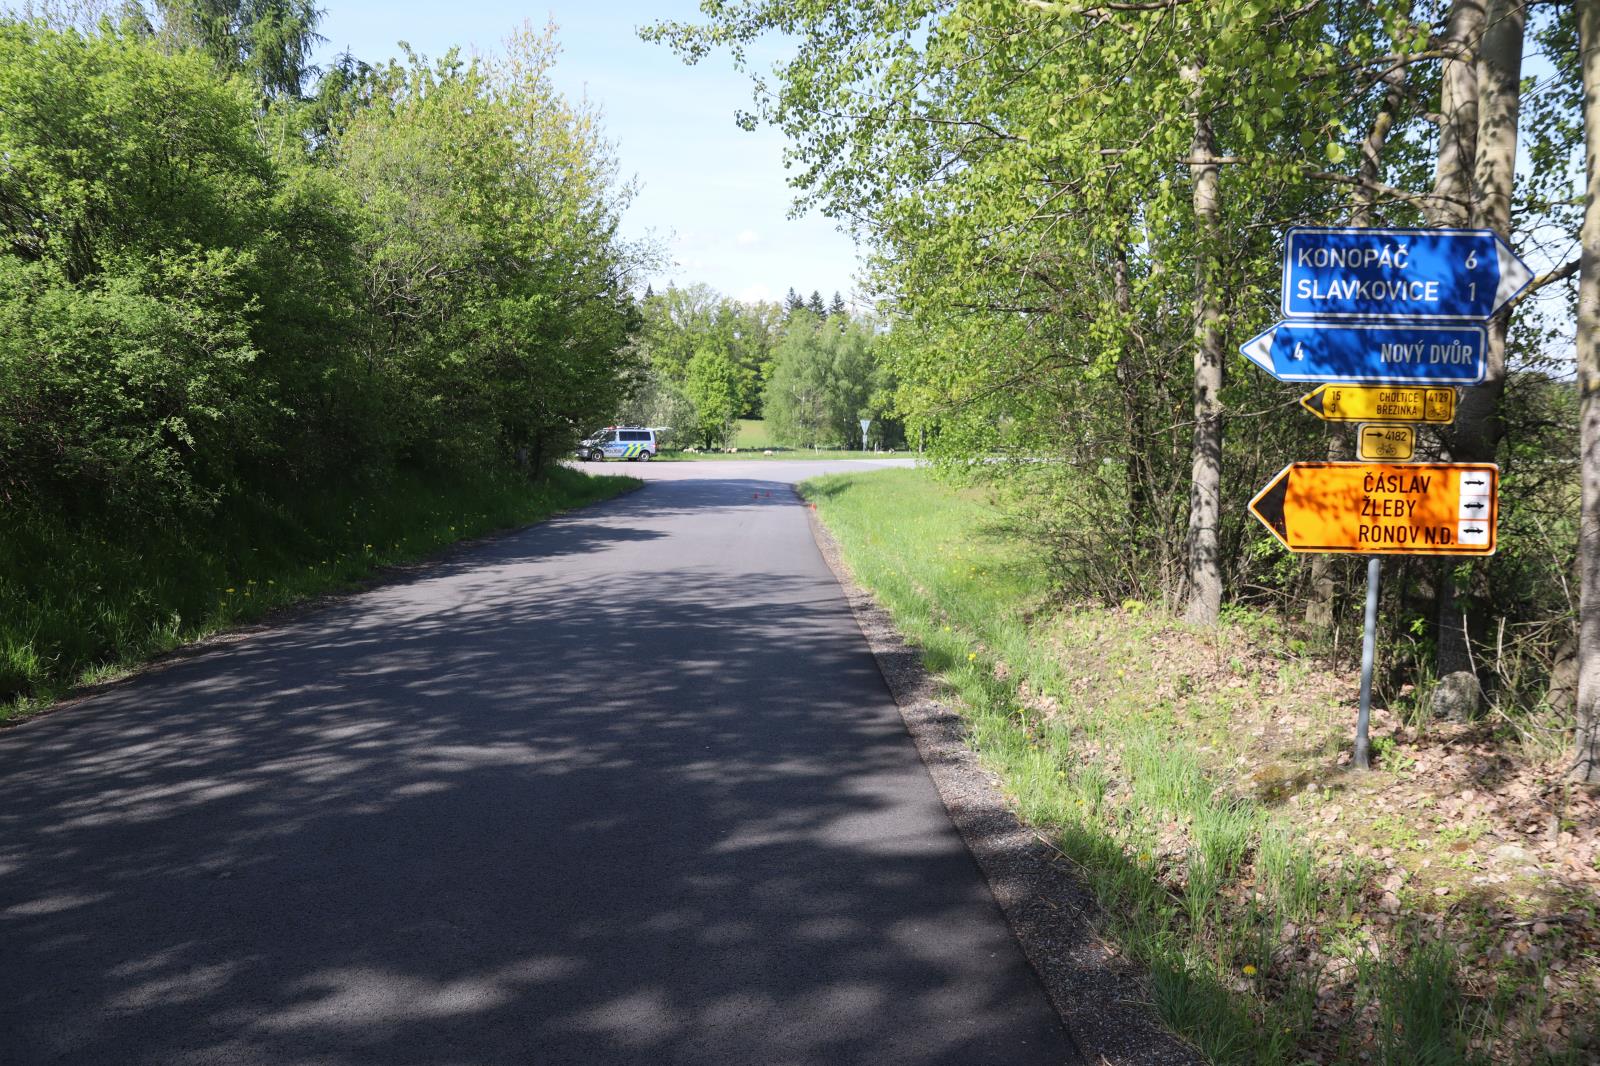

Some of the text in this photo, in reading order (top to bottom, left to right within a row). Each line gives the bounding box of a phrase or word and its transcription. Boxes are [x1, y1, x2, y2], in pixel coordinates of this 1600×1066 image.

[1297, 244, 1478, 270] KONOPÁČ 6
[1296, 279, 1476, 301] SLAVKOVICE 1
[1293, 339, 1472, 365] 4 NOVÝ DVŮR
[1332, 390, 1341, 401] 15
[1379, 392, 1418, 403] CHOLTICE
[1330, 403, 1417, 415] 3 BŘEZINKA
[1384, 431, 1407, 442] 4182
[1363, 471, 1431, 494] ČÁSLAV
[1361, 496, 1417, 517] ŽLEBY
[1358, 525, 1455, 545] RONOV N.D.
